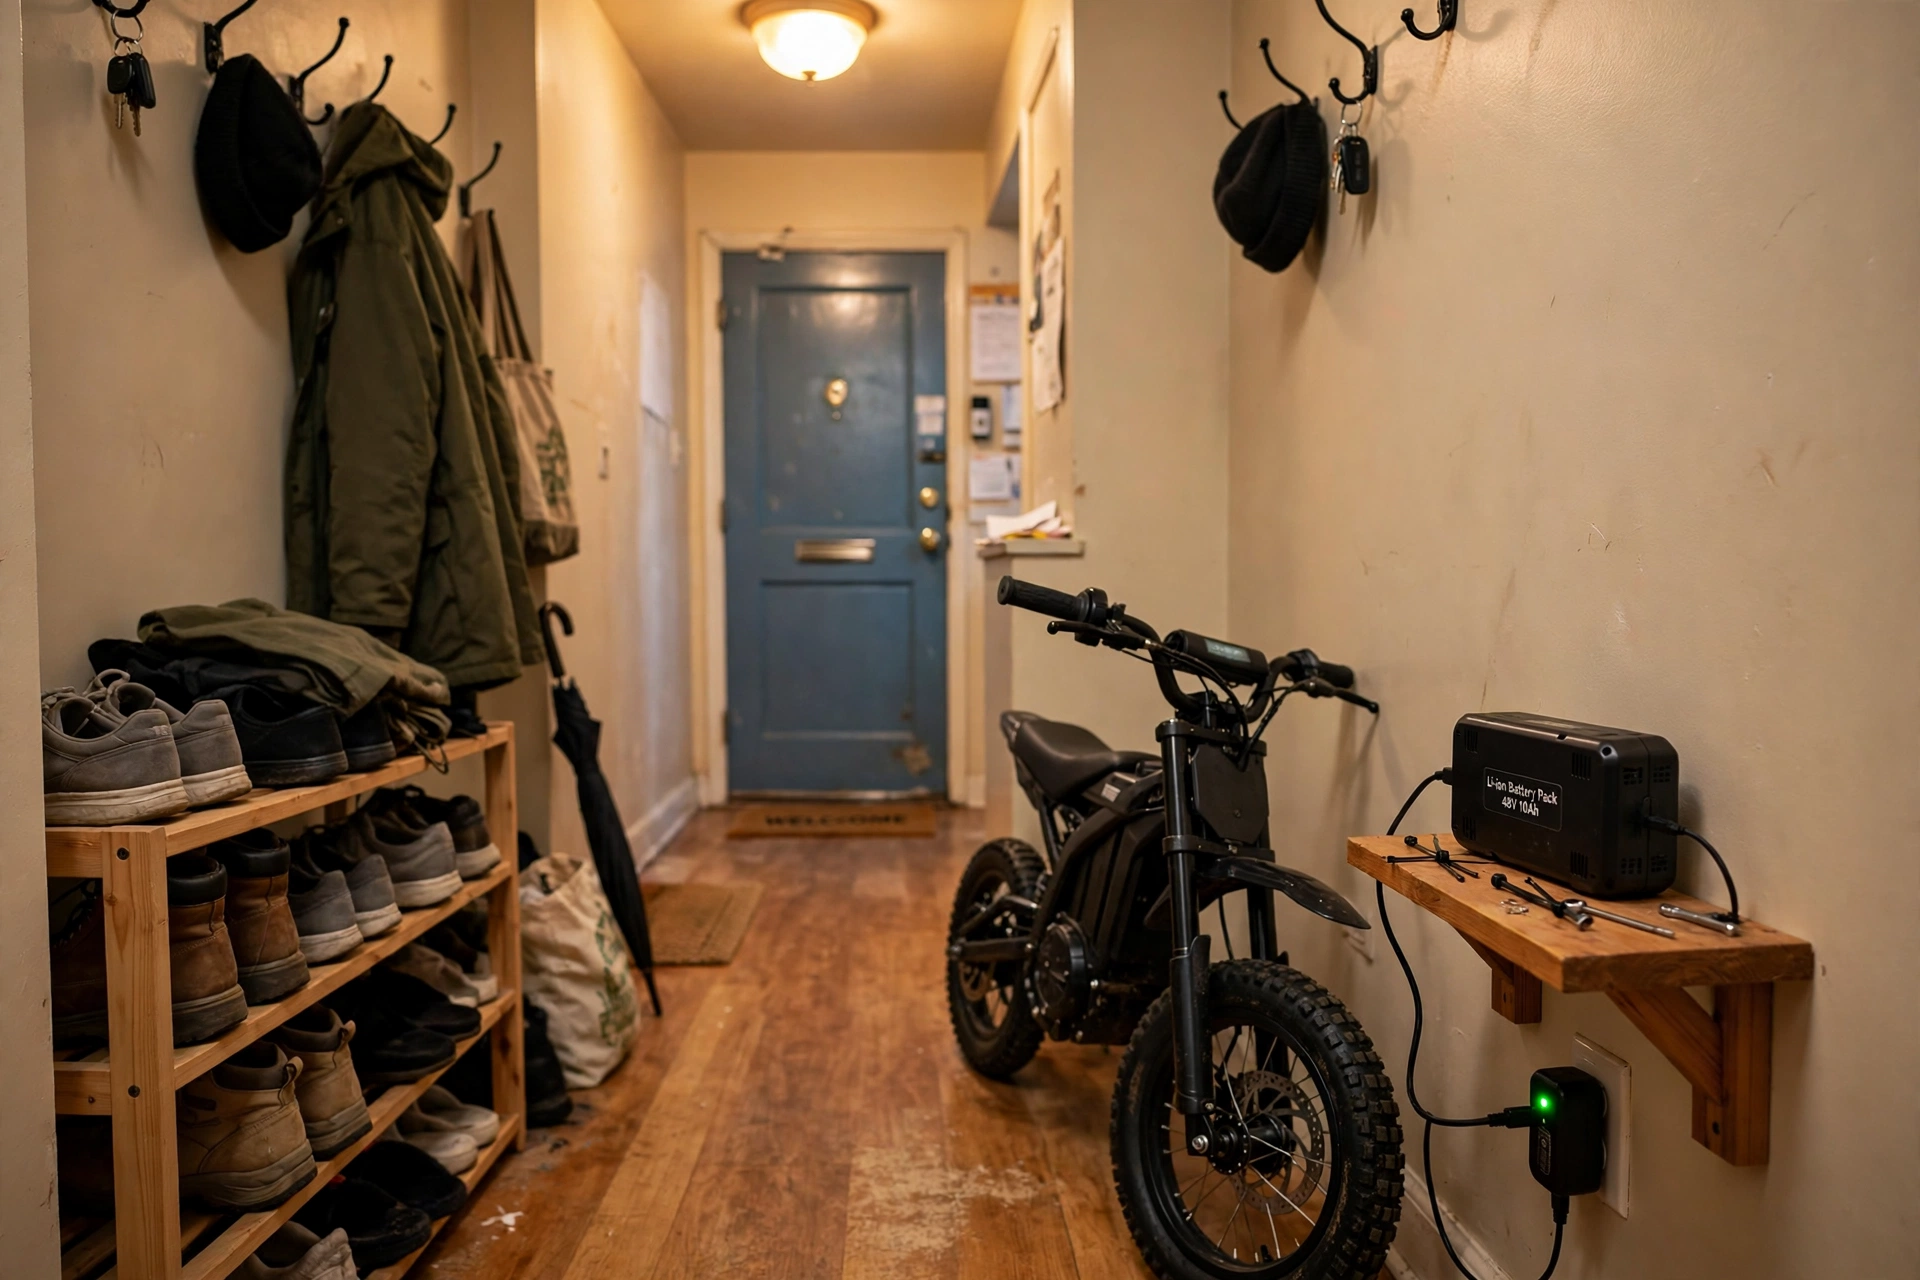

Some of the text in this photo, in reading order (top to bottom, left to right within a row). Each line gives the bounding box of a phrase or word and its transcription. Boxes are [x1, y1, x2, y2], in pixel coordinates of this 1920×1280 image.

[1487, 776, 1558, 805] Li-ion Battery Pack
[1501, 796, 1539, 817] 48V 10Ah
